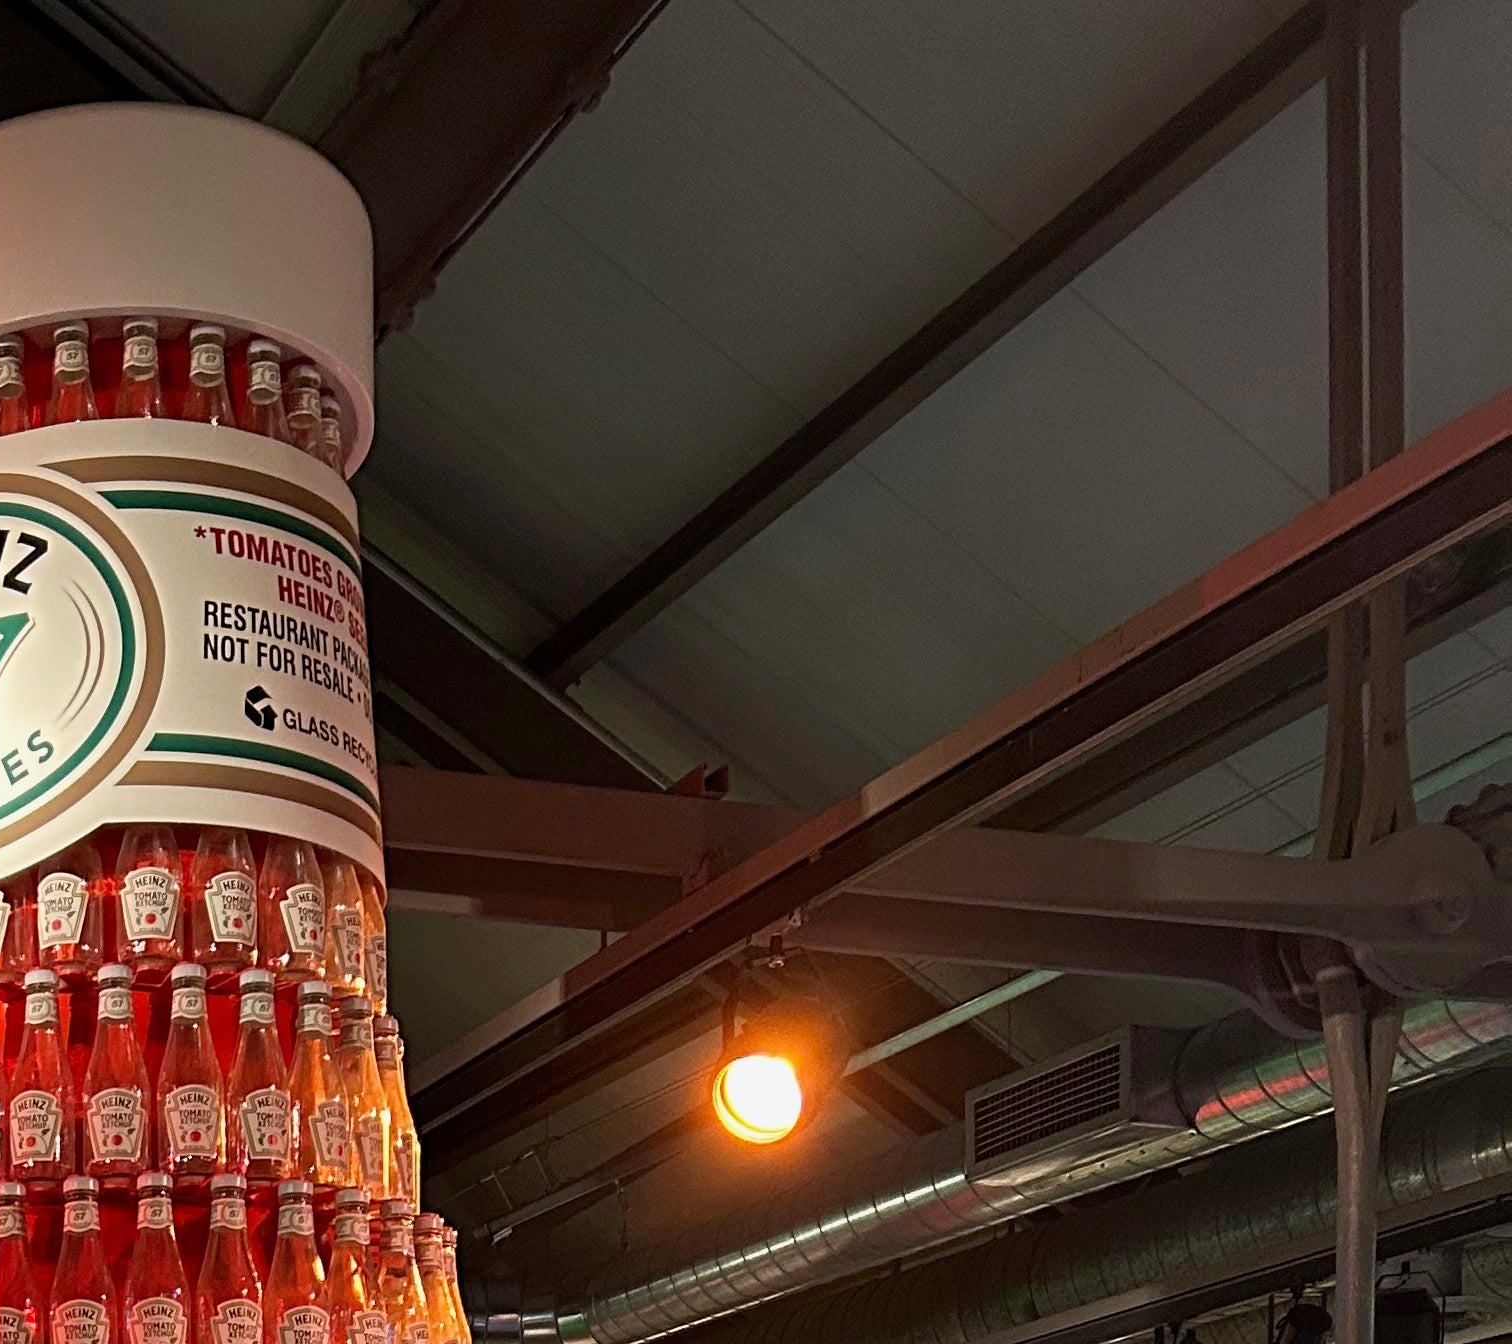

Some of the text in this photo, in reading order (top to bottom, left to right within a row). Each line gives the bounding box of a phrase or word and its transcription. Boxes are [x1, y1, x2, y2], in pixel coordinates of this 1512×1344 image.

[204, 600, 329, 657] RESTAURANT
[203, 633, 354, 705] NOT FOR RESALE
[283, 708, 339, 747] GLASS
[136, 877, 166, 889] HEINZ
[223, 880, 251, 893] HEINZ
[101, 1096, 131, 1108] HEINZ
[179, 1093, 210, 1106] HEINZ
